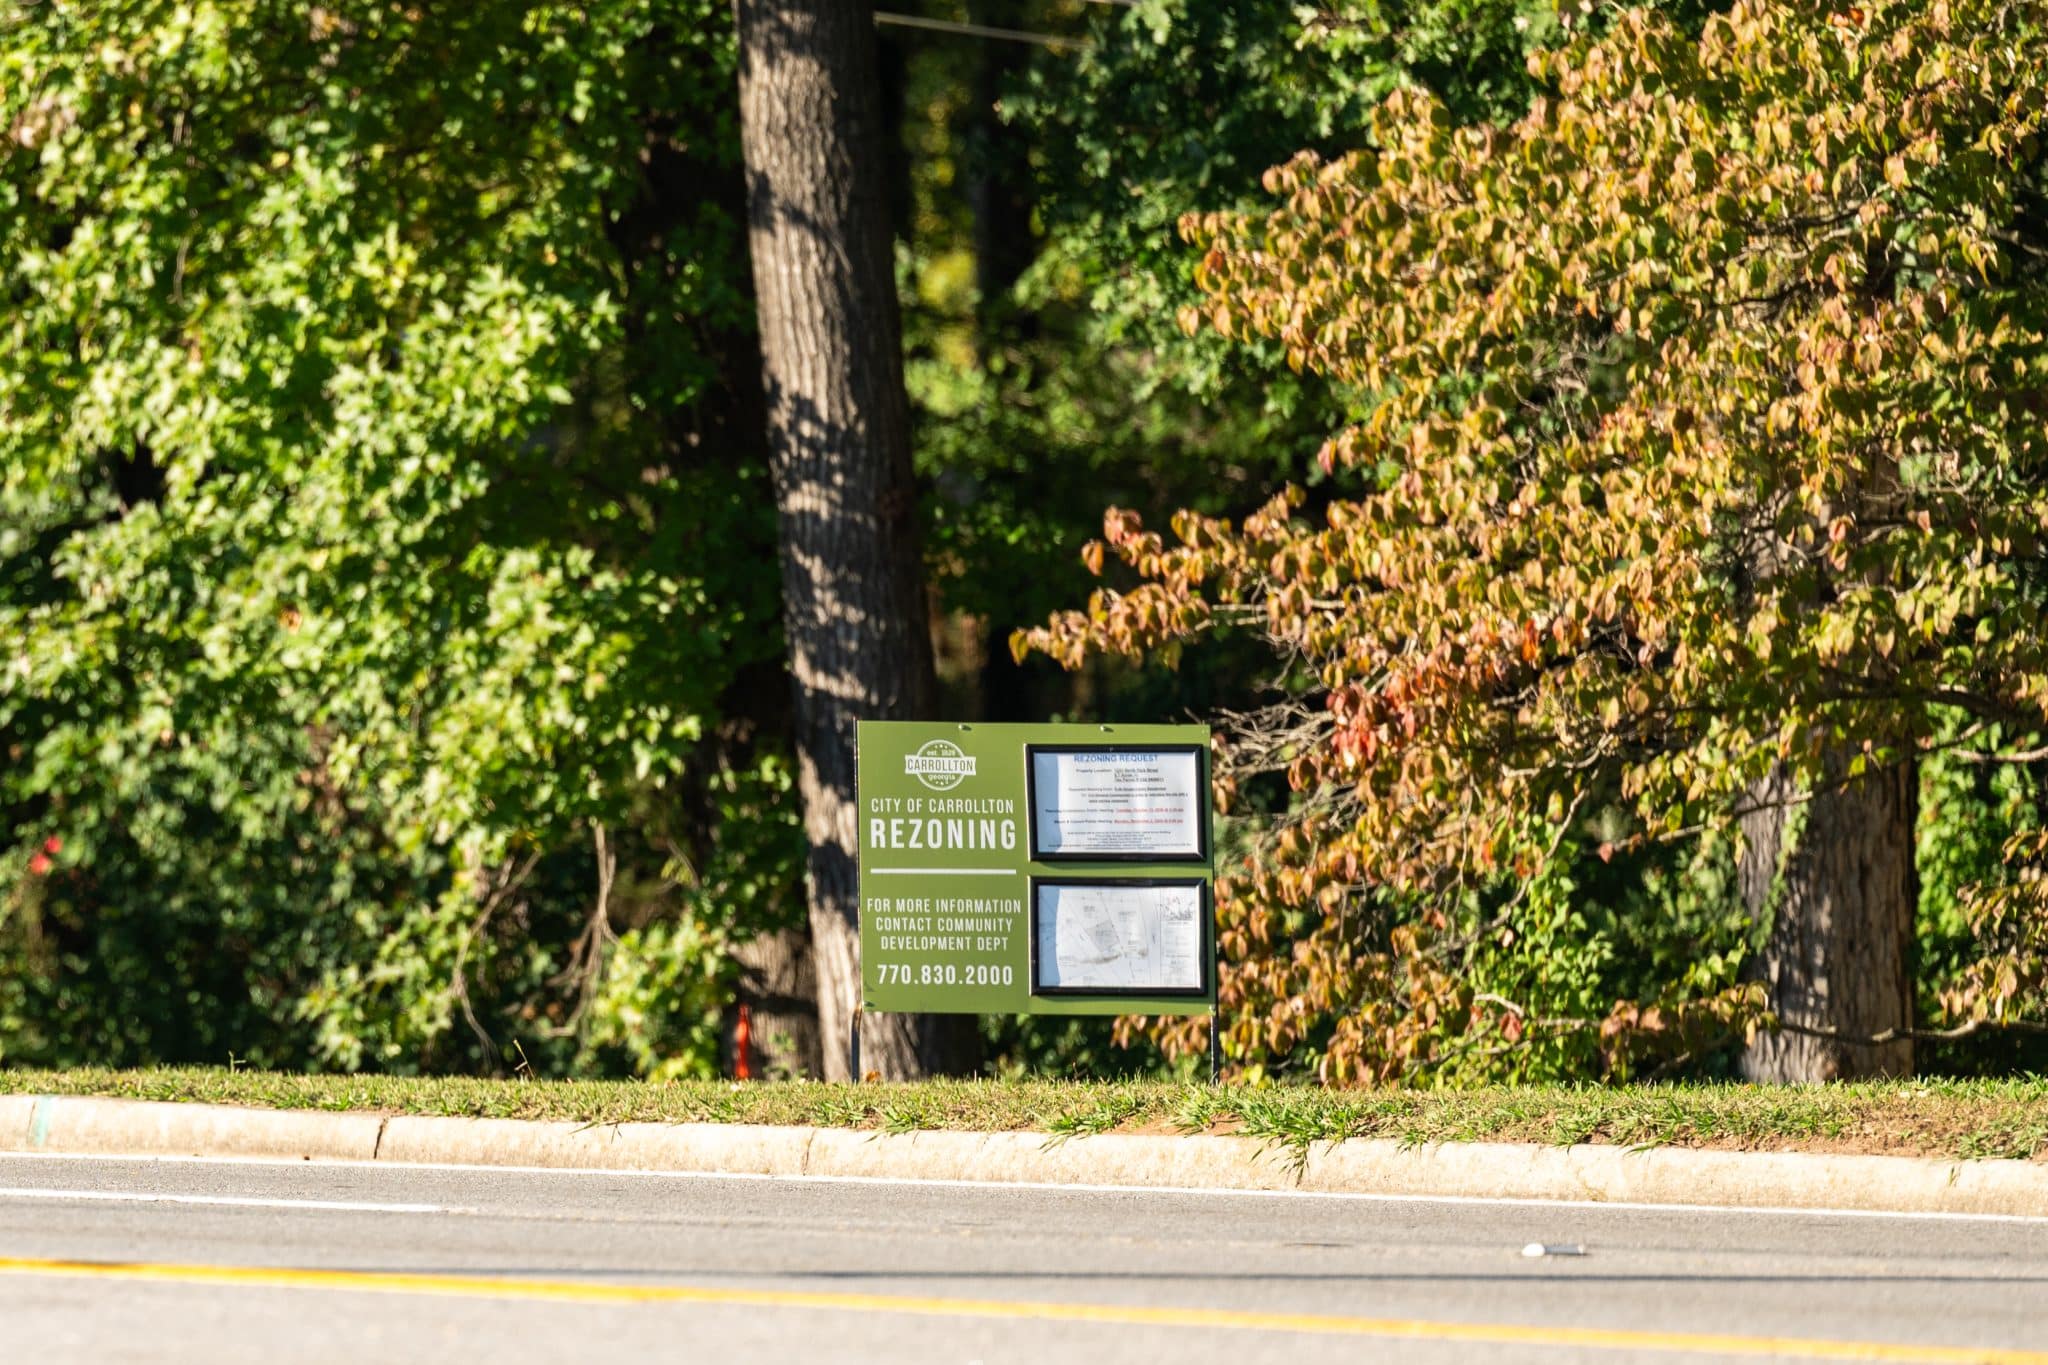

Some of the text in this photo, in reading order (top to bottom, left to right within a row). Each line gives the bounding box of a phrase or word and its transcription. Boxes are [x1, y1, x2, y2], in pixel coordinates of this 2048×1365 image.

[907, 758, 974, 772] CARROLLTON
[1073, 754, 1159, 763] REZONING REQUEST
[927, 774, 956, 784] georgia
[871, 797, 1014, 814] CITY OF CARROLLTON
[870, 818, 1016, 850] REZONING
[867, 898, 1022, 914] FOR MORE INFORMATION
[875, 916, 1013, 932] CONTACT COMMUNITY
[880, 935, 1009, 951] DEVELOPMENT DEPT
[877, 964, 1013, 986] 770.830.2000
